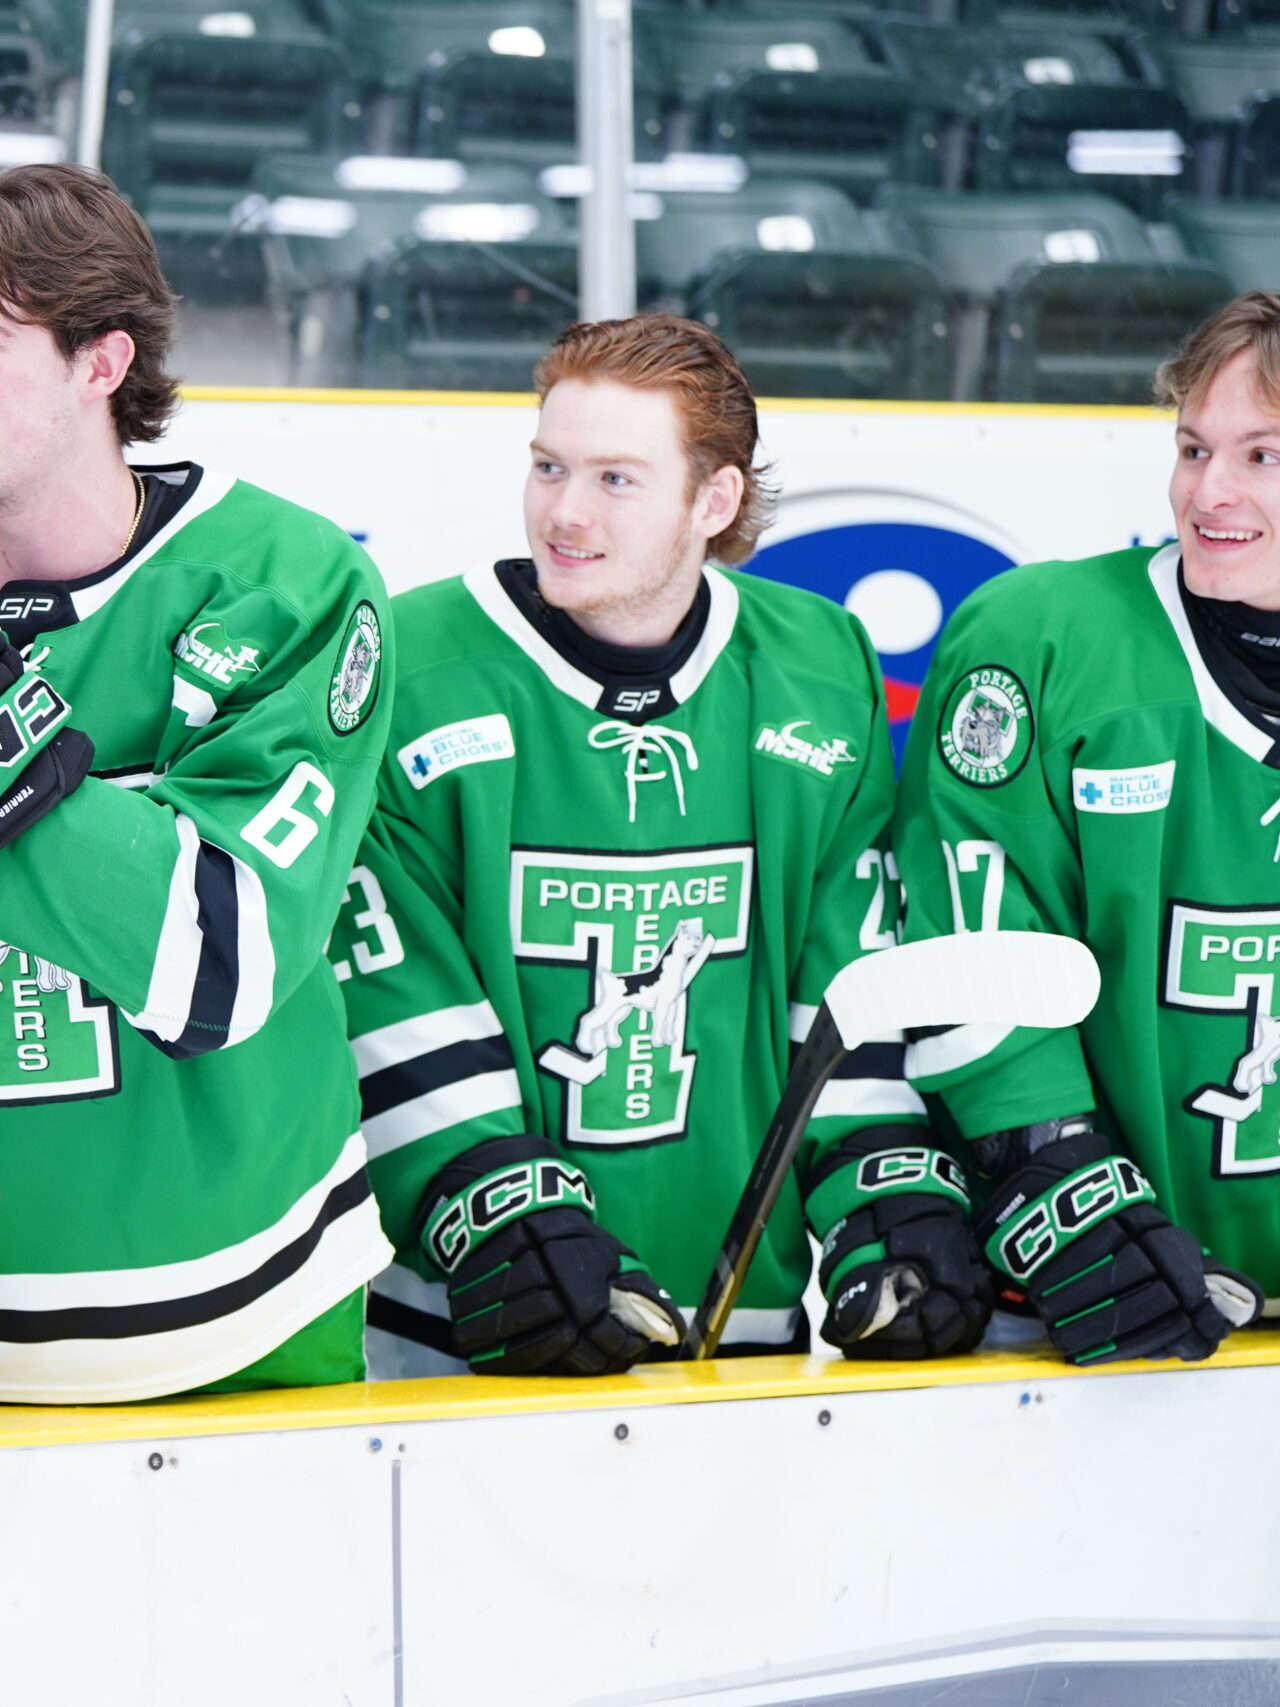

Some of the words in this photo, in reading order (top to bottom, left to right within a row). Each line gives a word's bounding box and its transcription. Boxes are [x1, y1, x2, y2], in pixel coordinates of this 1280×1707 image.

[613, 690, 660, 712] SP
[969, 670, 1028, 720] PORTAGE
[432, 731, 483, 755] BLUE
[438, 741, 503, 766] CROSS
[940, 731, 1008, 783] TERRIERS
[1110, 779, 1162, 794] BLUE
[240, 760, 336, 870] 6
[538, 875, 729, 912] PORTAGE
[322, 864, 405, 982] 3
[428, 1160, 597, 1274] CCM
